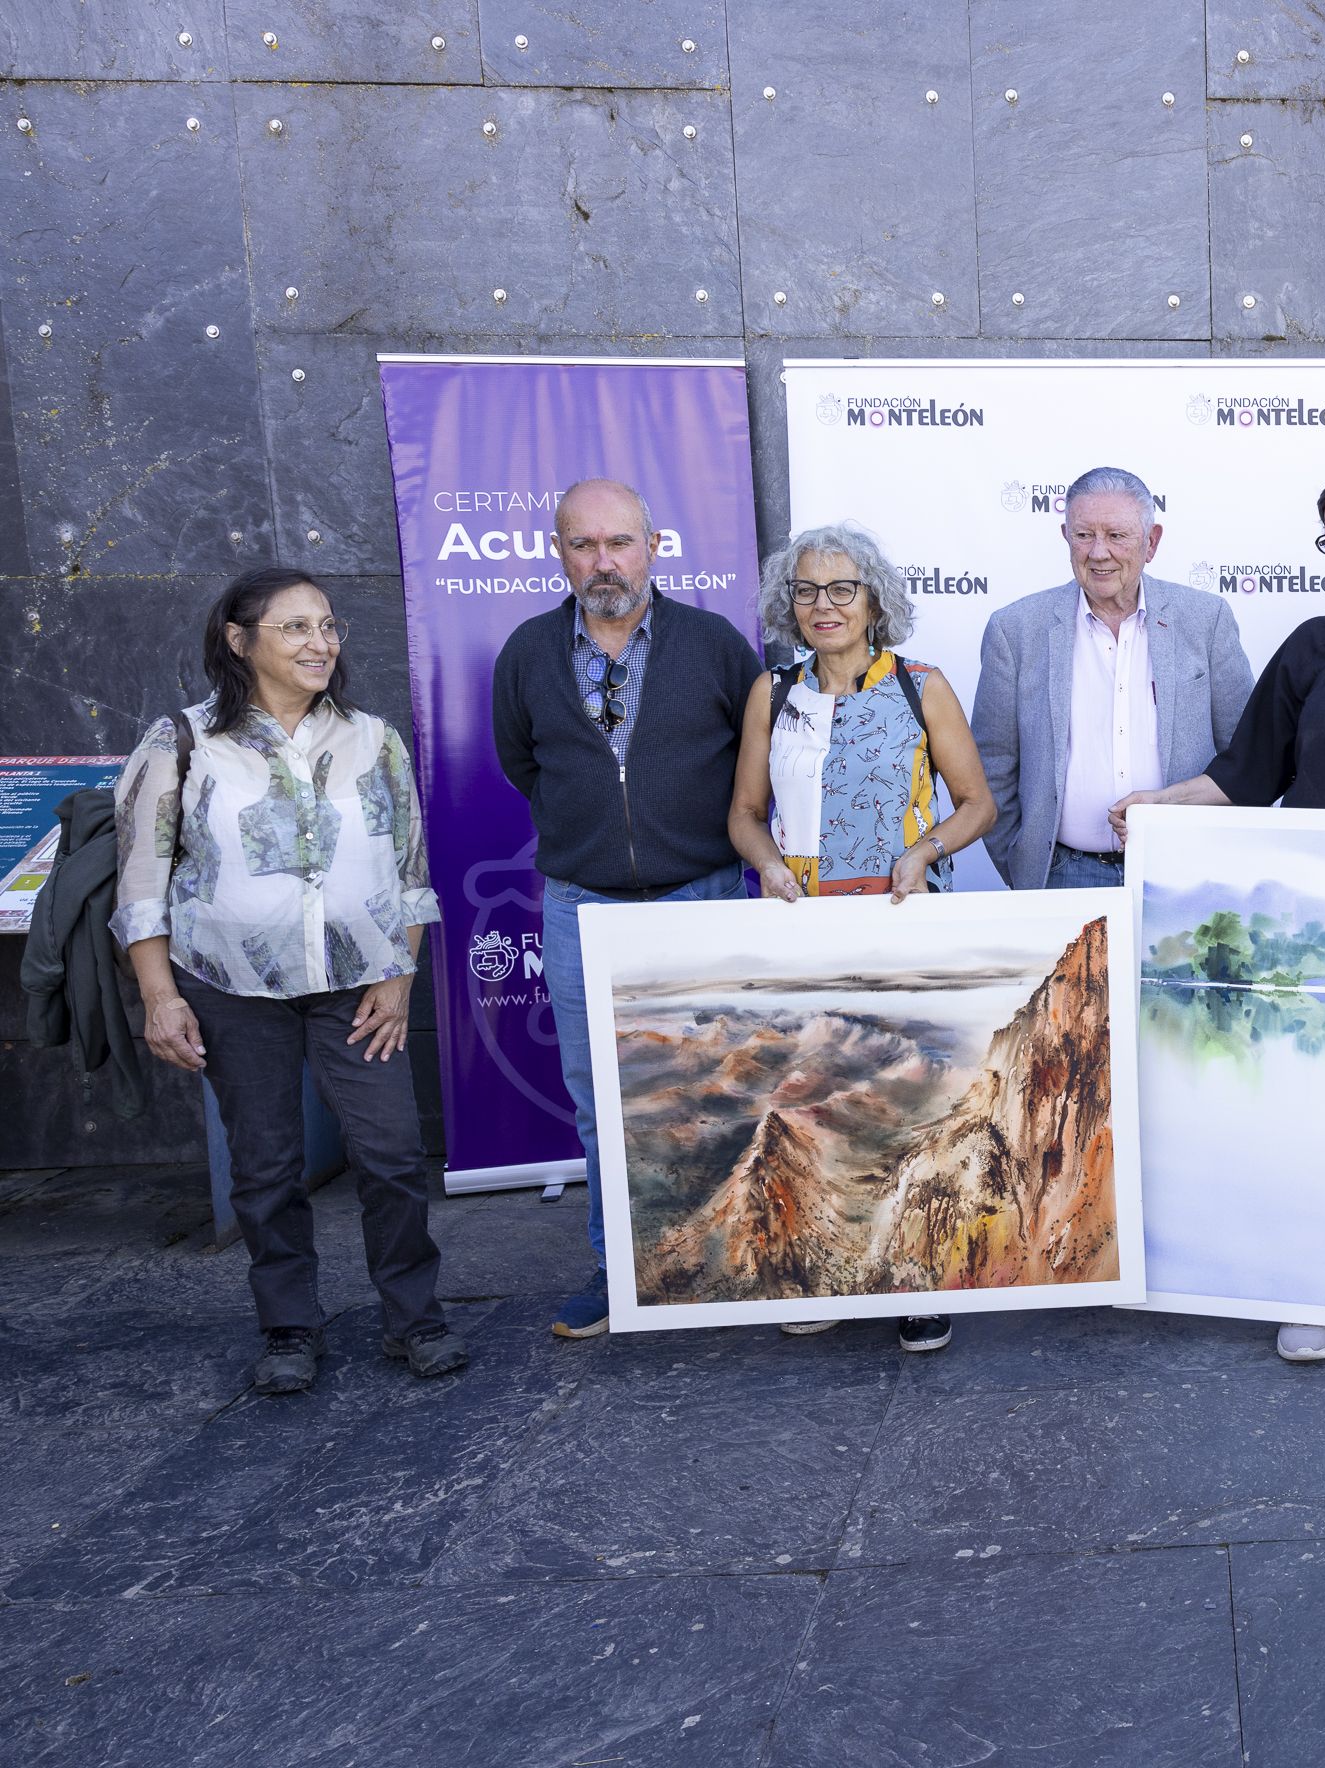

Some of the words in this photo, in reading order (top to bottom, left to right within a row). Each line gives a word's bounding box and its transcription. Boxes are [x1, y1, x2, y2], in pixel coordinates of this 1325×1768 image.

[847, 396, 921, 408] FUNDACIÓN
[1217, 396, 1290, 408] FUNDACIÓN
[847, 399, 984, 427] MONTELEÓN
[433, 491, 566, 512] CERTAME
[1220, 562, 1292, 575] FUNDACIÓN
[904, 567, 988, 595] TELEÓN
[0, 757, 54, 765] PARQUE
